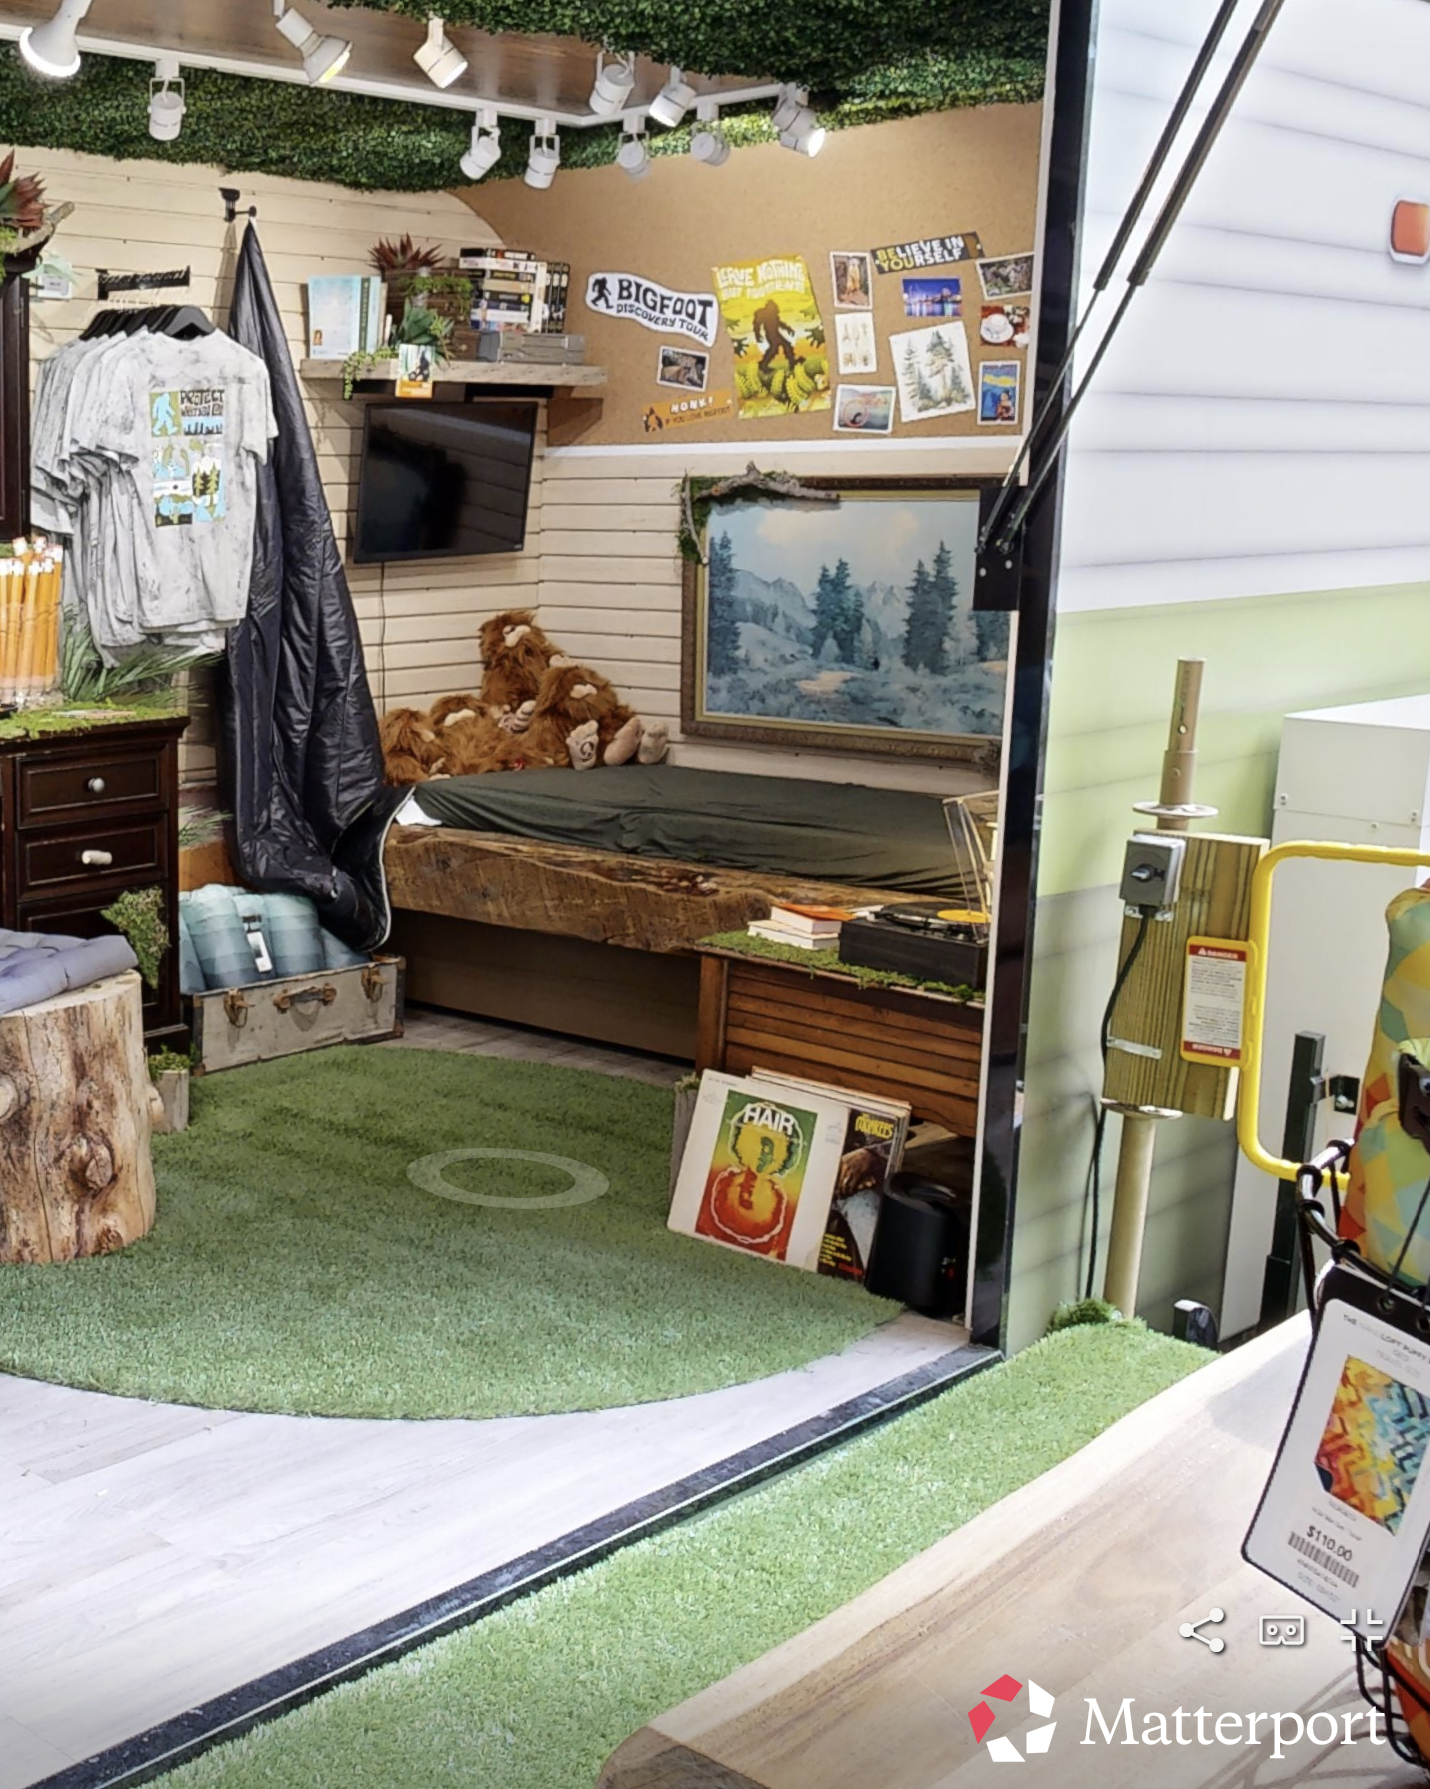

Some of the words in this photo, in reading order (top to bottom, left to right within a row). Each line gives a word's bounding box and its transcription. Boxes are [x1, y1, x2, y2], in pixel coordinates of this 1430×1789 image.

[876, 240, 943, 261] BELIEVE
[944, 236, 964, 250] IN
[880, 248, 962, 272] YOURSELF
[617, 279, 713, 329] BIGFOOT
[616, 303, 676, 327] DISCOVERY
[679, 319, 708, 341] TOUR
[181, 389, 225, 405] PROTECT
[743, 1103, 795, 1135] HAIR
[1306, 1525, 1353, 1561] $110.00
